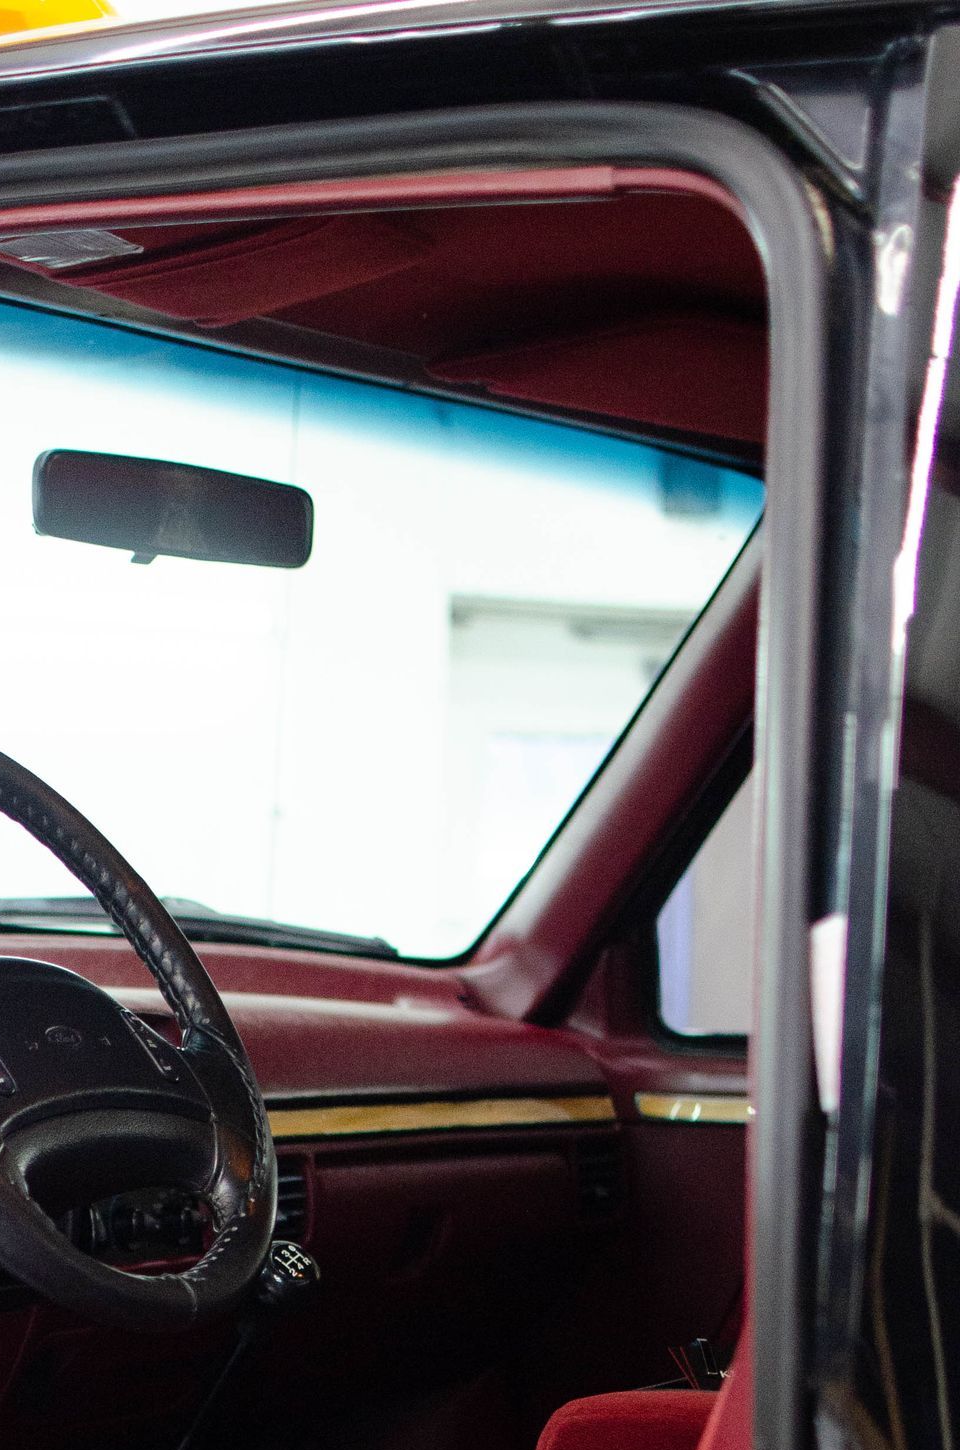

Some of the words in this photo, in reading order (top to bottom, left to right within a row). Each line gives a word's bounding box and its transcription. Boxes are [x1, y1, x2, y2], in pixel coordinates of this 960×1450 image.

[281, 1249, 290, 1257] 3
[302, 1256, 312, 1266] R
[289, 1268, 298, 1277] 2
